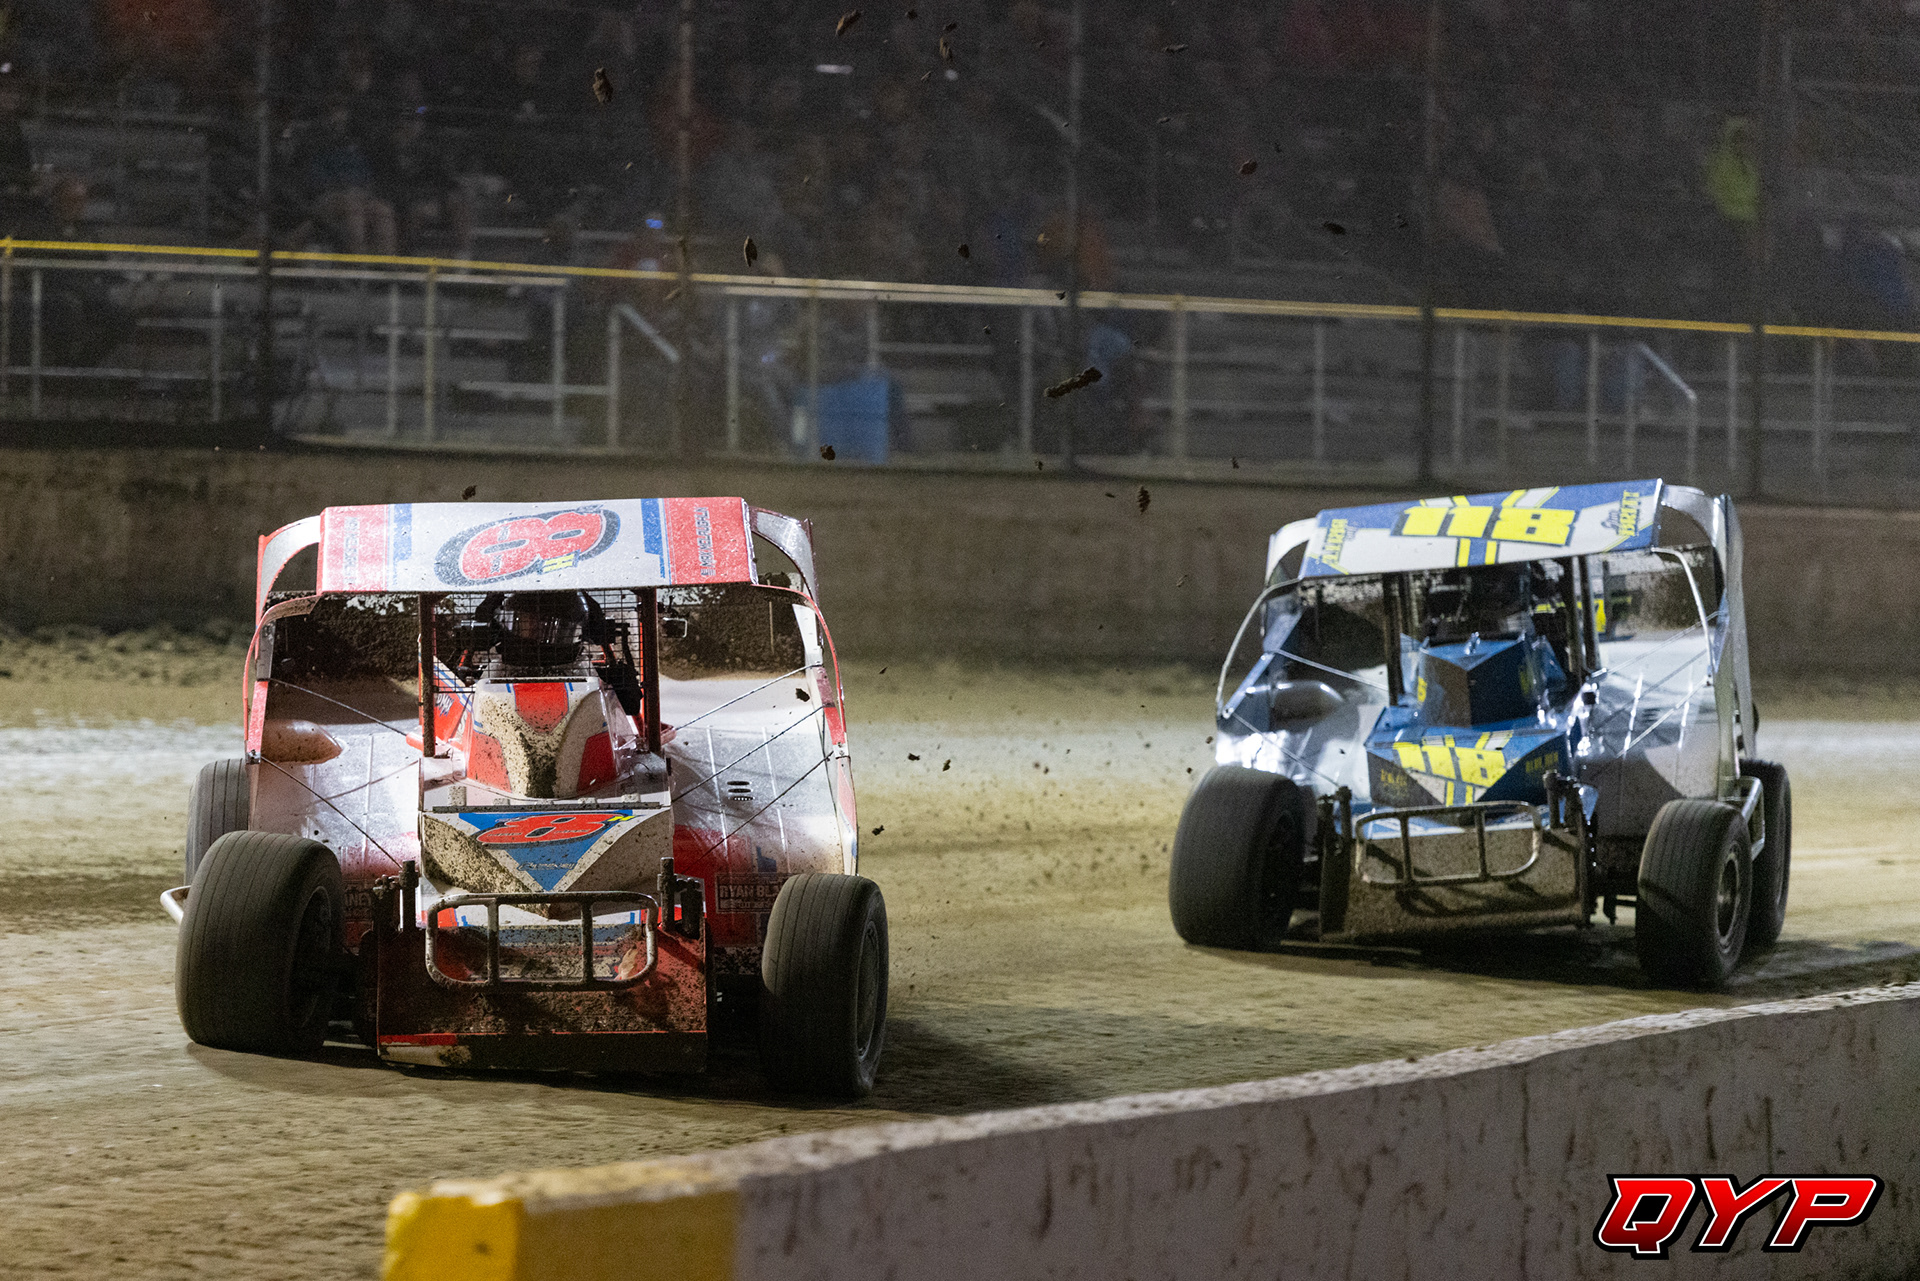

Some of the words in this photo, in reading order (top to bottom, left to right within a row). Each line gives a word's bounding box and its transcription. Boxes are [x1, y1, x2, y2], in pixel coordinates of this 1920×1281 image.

[1399, 504, 1576, 545] 118
[1617, 489, 1640, 537] BRITT
[1393, 741, 1507, 789] 118
[719, 884, 754, 898] RYAN
[756, 884, 782, 898] BLA
